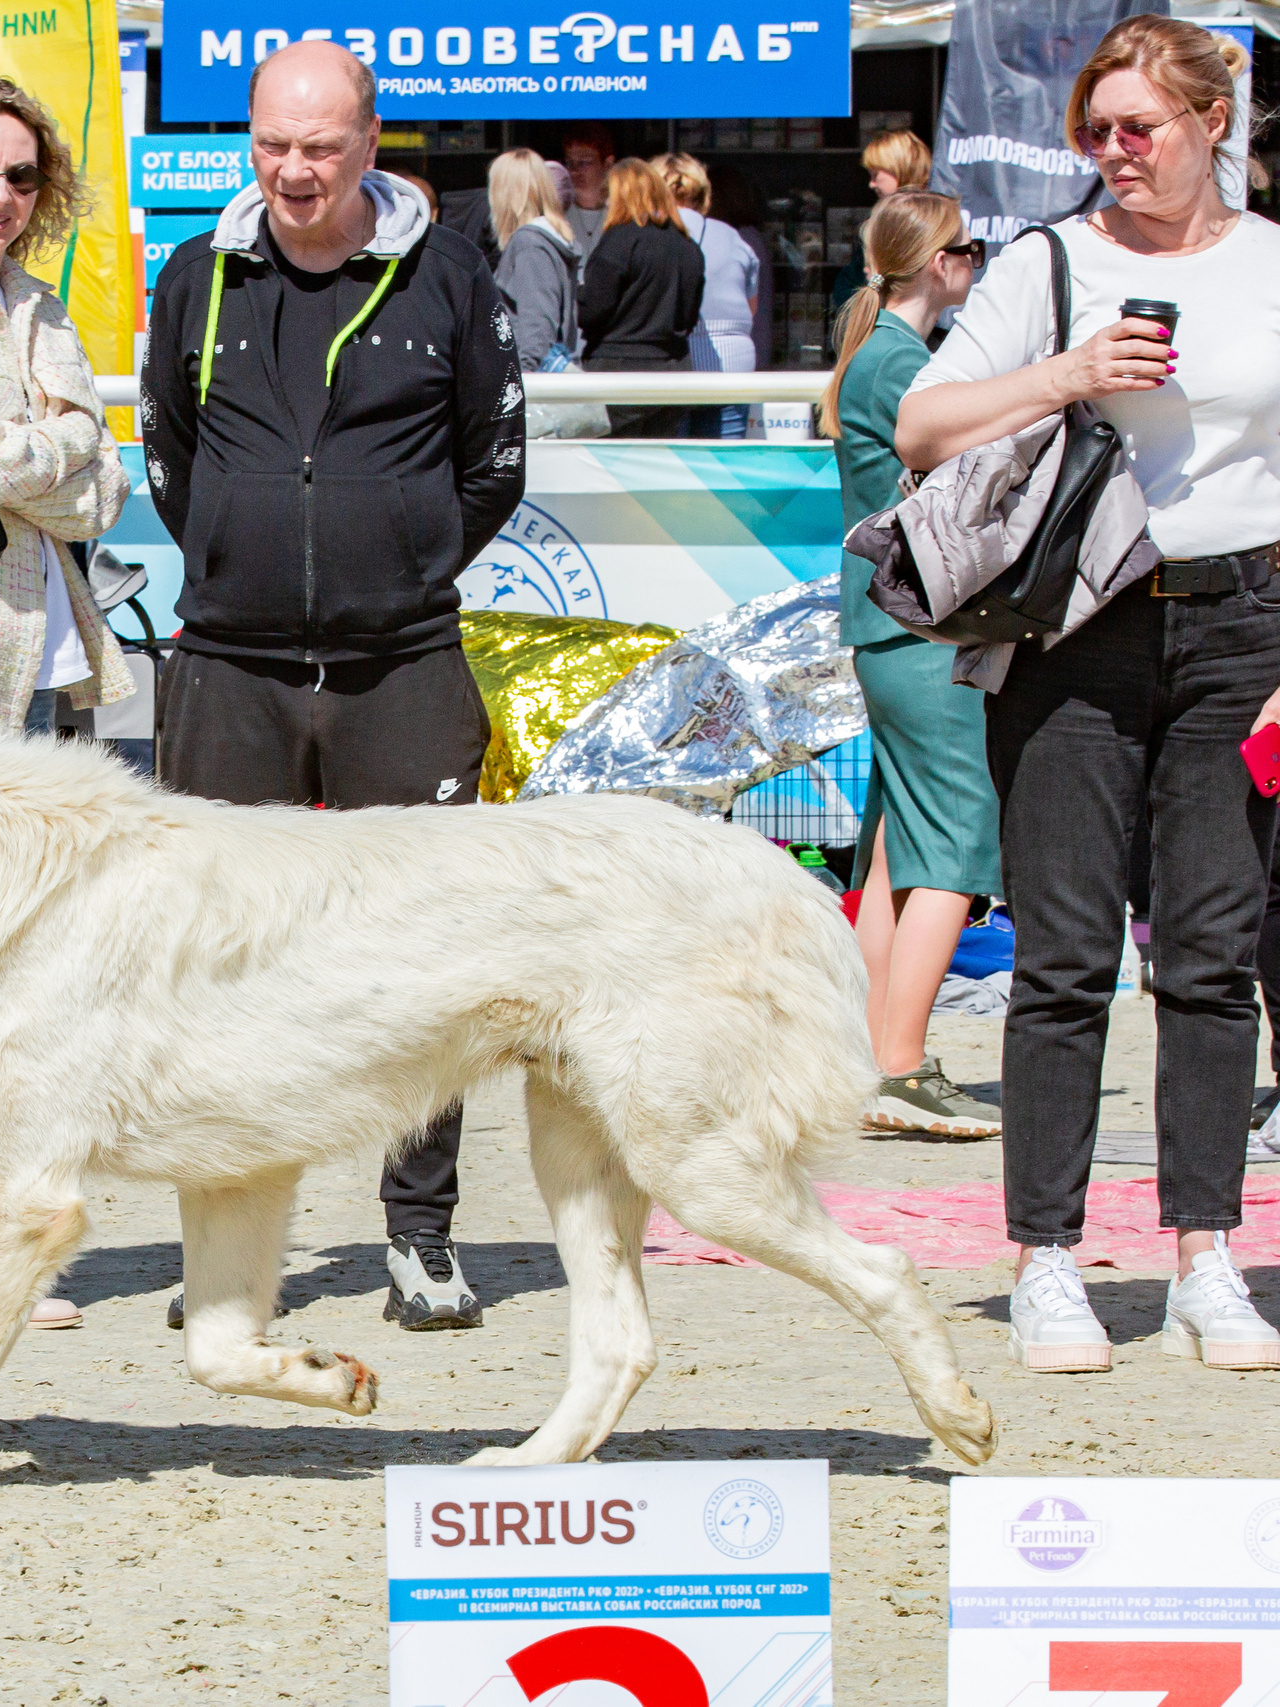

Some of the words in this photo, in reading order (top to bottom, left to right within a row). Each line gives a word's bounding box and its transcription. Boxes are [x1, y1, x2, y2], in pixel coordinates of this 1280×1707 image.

[449, 76, 540, 94] ЗАБОТЯСЬ
[543, 76, 558, 92] О
[561, 75, 647, 91] ГЛАВНОМ
[142, 152, 173, 169] ОТ
[179, 152, 242, 169] БЛОХ
[142, 168, 242, 192] КЛЕЩЕЙ
[414, 1501, 423, 1548] PREMIUM
[1010, 1524, 1095, 1544] Farmina
[1029, 1550, 1045, 1561] Pet
[1047, 1550, 1076, 1561] Foods
[410, 1588, 469, 1600] «ЕВРАЗИЯ.
[471, 1588, 509, 1599] КУБОК
[512, 1586, 585, 1599] ПРЕЗИДЕНТА
[588, 1586, 612, 1598] РКФ
[614, 1586, 644, 1597] 2022»
[653, 1585, 712, 1596] «ЕВРАЗИЯ.
[715, 1584, 752, 1595] КУБОК
[755, 1584, 776, 1595] СНГ
[779, 1583, 809, 1595] 2022»
[470, 1602, 538, 1613] ВСЕМИРНАЯ
[541, 1601, 601, 1612] ВЫСТАВКА
[604, 1600, 641, 1611] СОБАК
[643, 1598, 719, 1610] РОССИЙСКИХ
[722, 1598, 761, 1610] ПОРОД
[1012, 1597, 1049, 1607] КУБОК
[1052, 1597, 1124, 1608] ПРЕЗИДЕНТА
[1127, 1597, 1151, 1607] РКФ
[1154, 1597, 1183, 1608] 2022»
[1193, 1597, 1252, 1608] «ЕВРАЗИЯ.
[1010, 1610, 1077, 1621] ВСЕМИРНАЯ
[1080, 1610, 1140, 1621] ВЫСТАВКА
[1143, 1610, 1180, 1621] СОБАК
[1183, 1609, 1258, 1622] РОССИЙСКИХ
